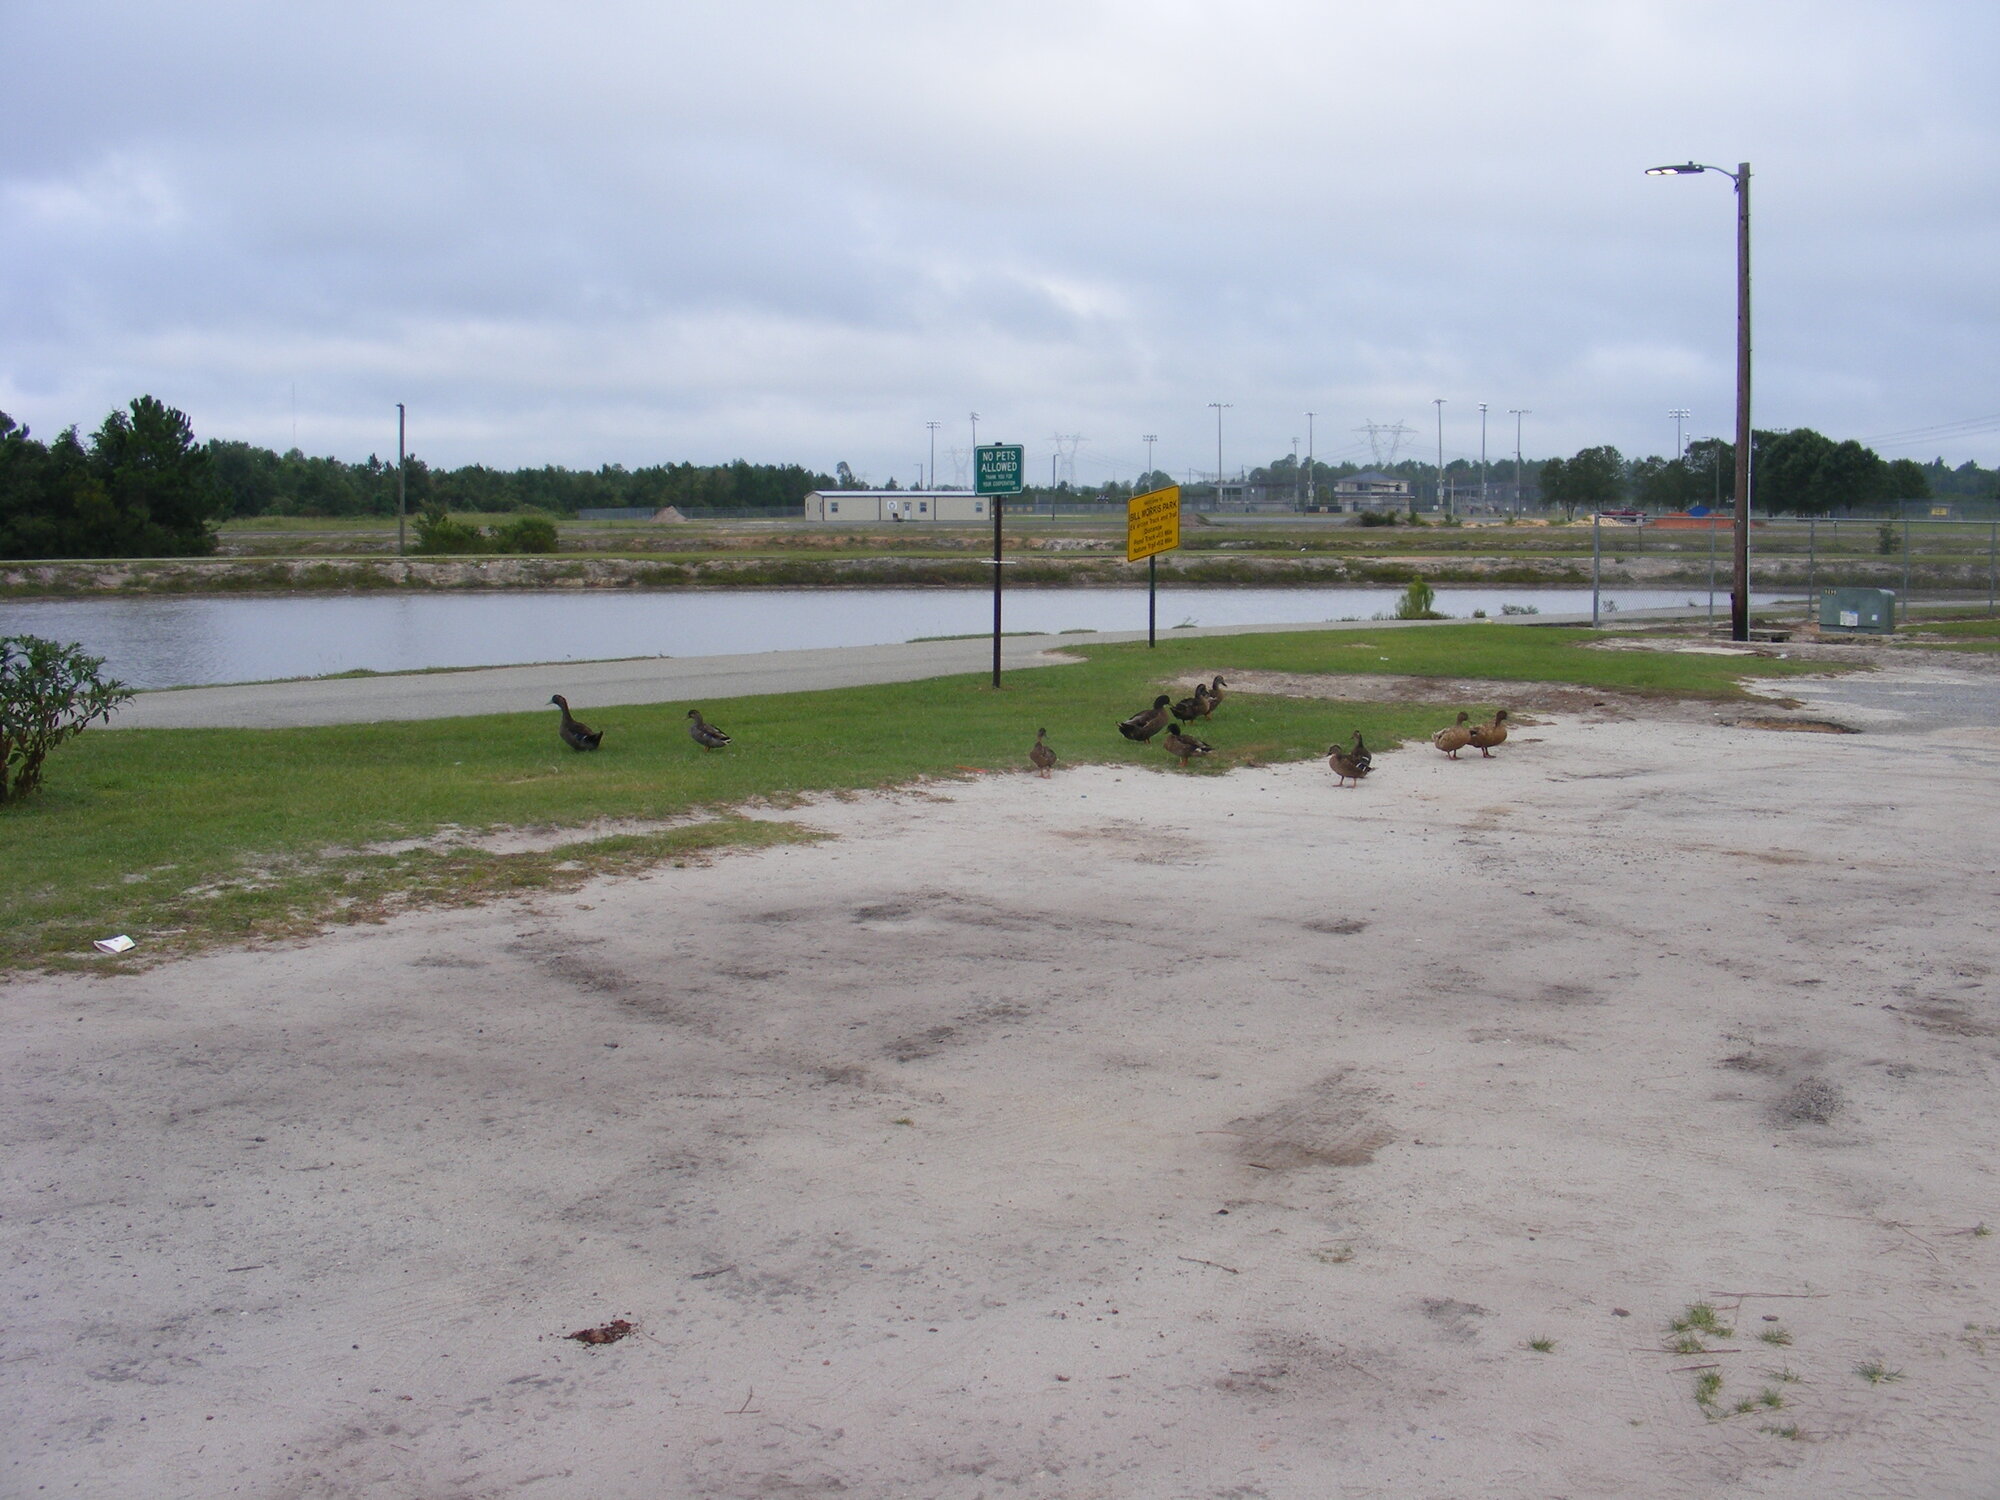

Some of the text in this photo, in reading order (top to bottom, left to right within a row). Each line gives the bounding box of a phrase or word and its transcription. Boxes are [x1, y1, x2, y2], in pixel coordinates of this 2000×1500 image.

[983, 451, 1016, 462] NO PETS
[981, 462, 1017, 472] ALLOWED
[1130, 512, 1140, 522] BILL
[1142, 504, 1162, 519] MORRIS
[1162, 500, 1178, 512] PARK
